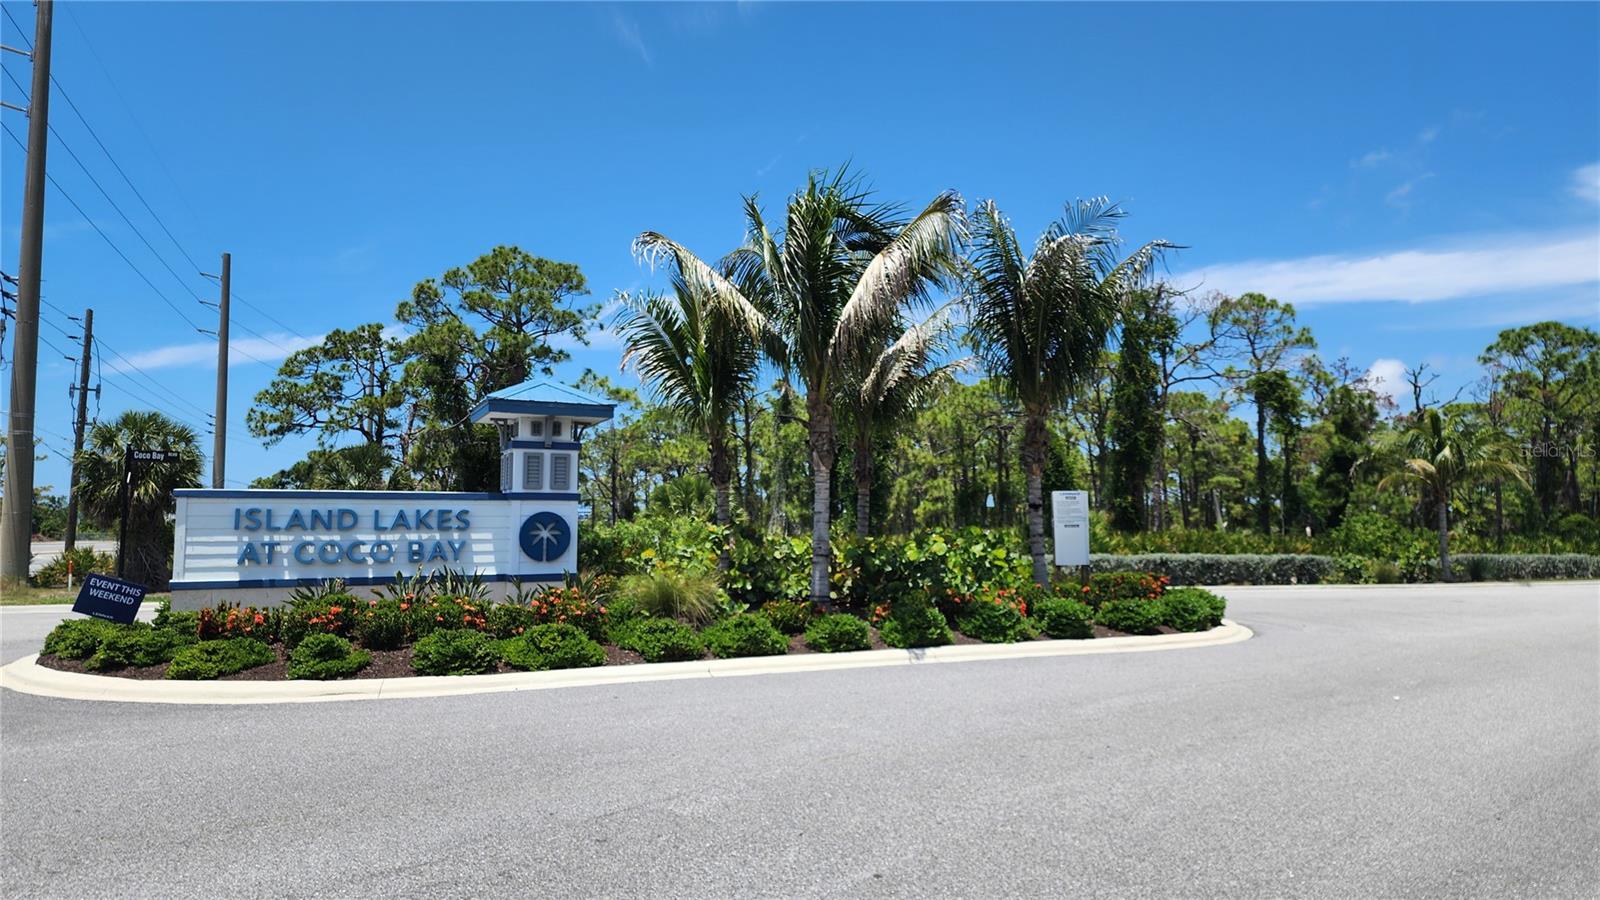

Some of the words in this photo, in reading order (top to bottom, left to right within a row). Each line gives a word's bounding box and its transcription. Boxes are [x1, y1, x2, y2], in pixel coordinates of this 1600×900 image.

[134, 451, 151, 459] Coco
[152, 451, 165, 461] Bay
[234, 508, 359, 531] ISLAND
[374, 509, 471, 531] LAKES
[237, 542, 280, 565] AT
[294, 540, 395, 565] COCO
[408, 540, 466, 563] BAY
[89, 577, 121, 592] EVENT
[121, 584, 142, 597] THIS
[89, 587, 135, 605] WEEKEND
